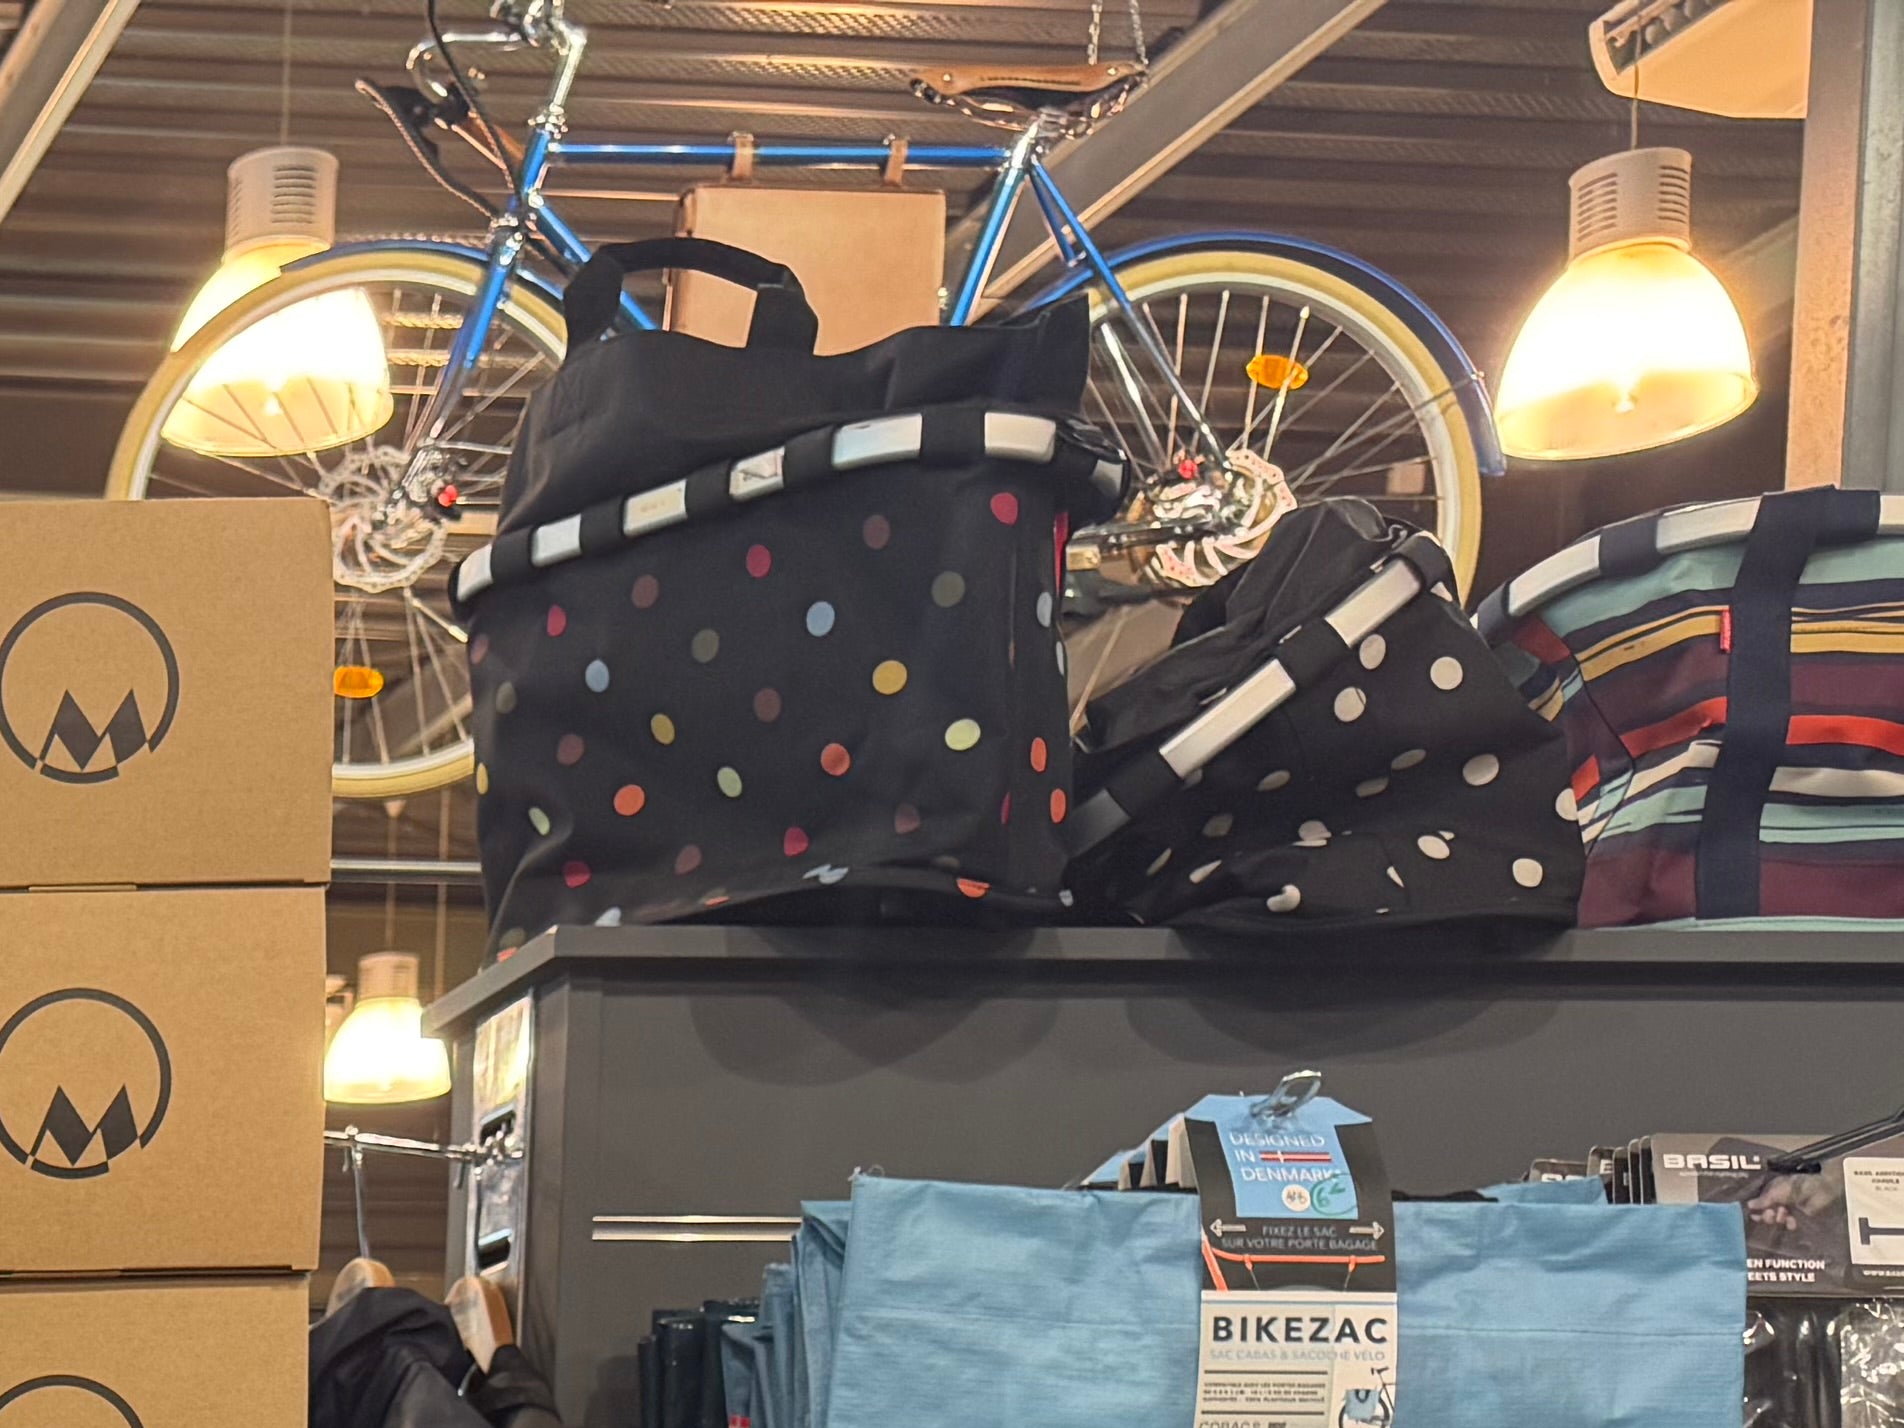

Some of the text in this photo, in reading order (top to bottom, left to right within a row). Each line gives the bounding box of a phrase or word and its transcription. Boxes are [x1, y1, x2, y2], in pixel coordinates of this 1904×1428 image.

[1229, 1131, 1325, 1147] DESIGNED
[1235, 1150, 1255, 1162] IN
[1663, 1154, 1762, 1170] BASIL
[1263, 1226, 1336, 1238] FIXEZ LE SAC
[1247, 1238, 1286, 1249] VOTRE
[1290, 1239, 1327, 1250] PORTE
[1765, 1258, 1825, 1270] FUNCTION
[1780, 1271, 1816, 1283] STYLE
[1212, 1316, 1388, 1344] BIKEZAC
